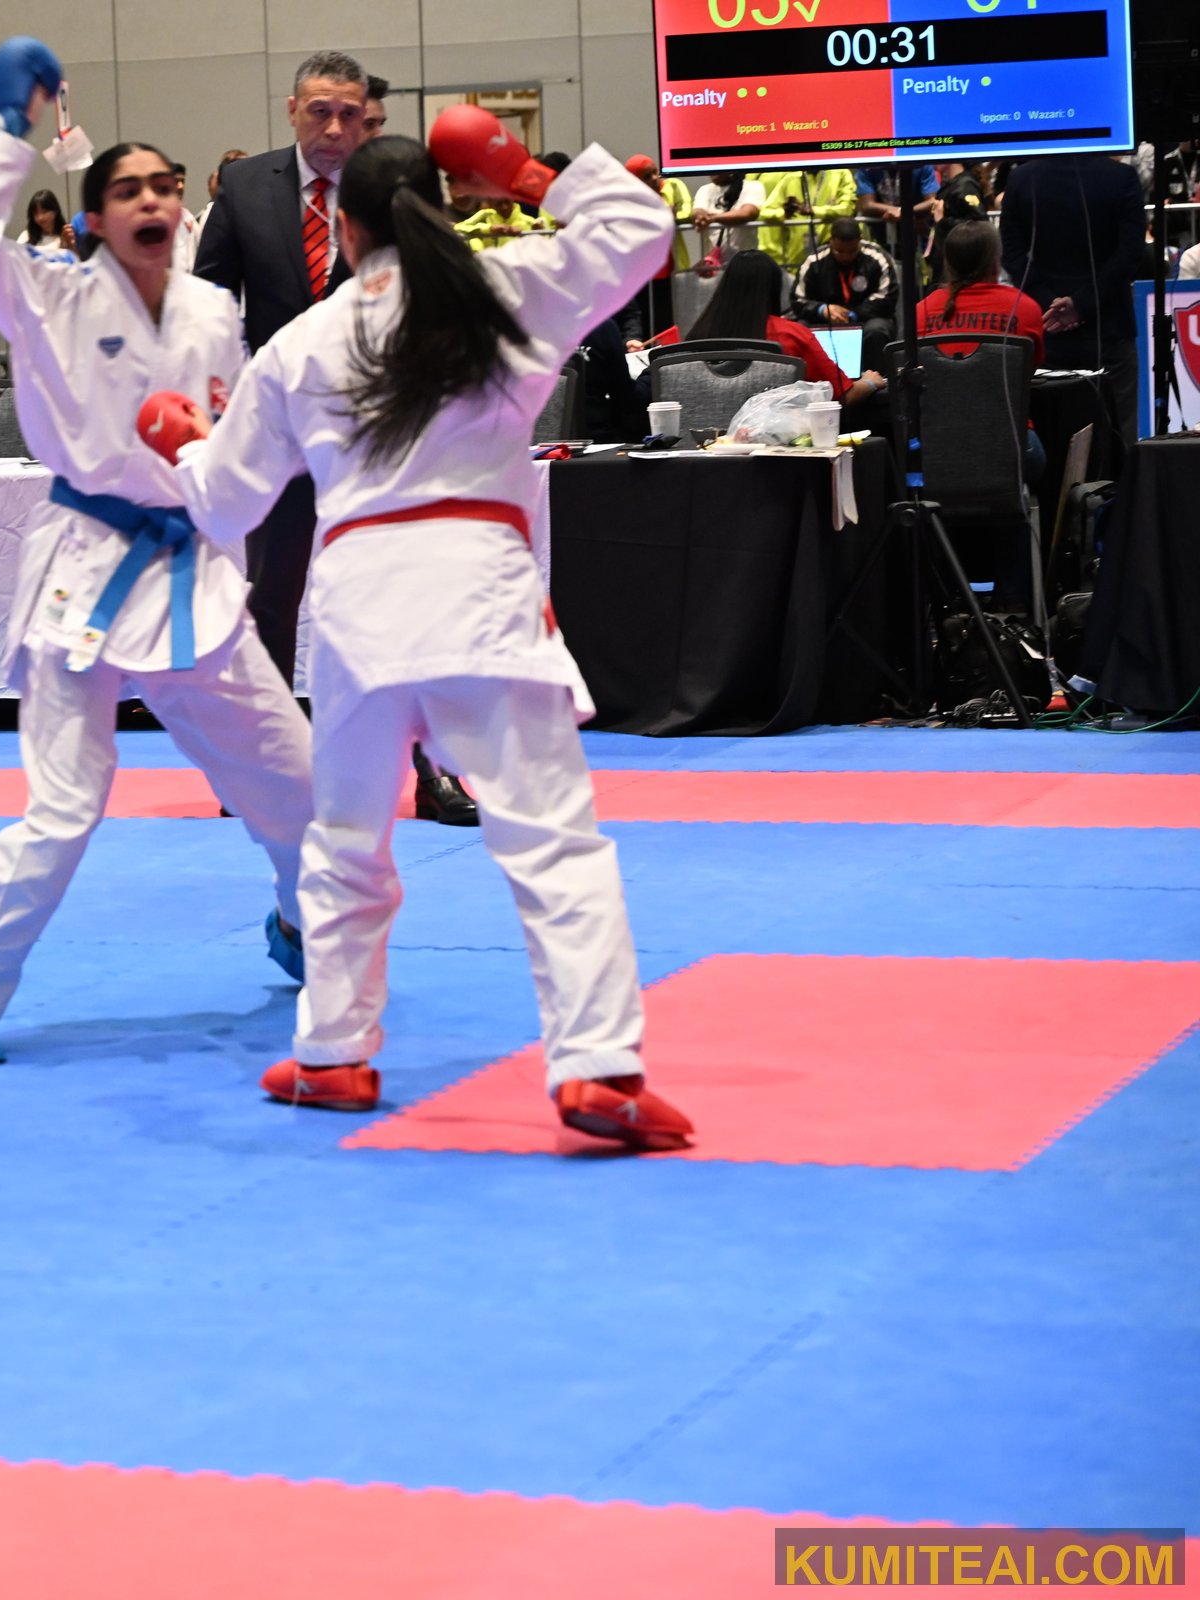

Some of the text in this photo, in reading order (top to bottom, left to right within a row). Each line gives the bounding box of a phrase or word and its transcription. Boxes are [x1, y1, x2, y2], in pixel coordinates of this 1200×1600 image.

[826, 24, 935, 66] 00:31
[902, 75, 970, 95] Penalty
[661, 88, 727, 108] Penalty
[980, 108, 1075, 124] Ippon: 0 Wazari: 0
[736, 119, 829, 135] Ippon: 1 Wazari: 0
[864, 140, 888, 148] Female
[889, 138, 905, 147] Elite
[905, 138, 930, 146] Kumite
[926, 312, 1018, 334] VOLUNTEER
